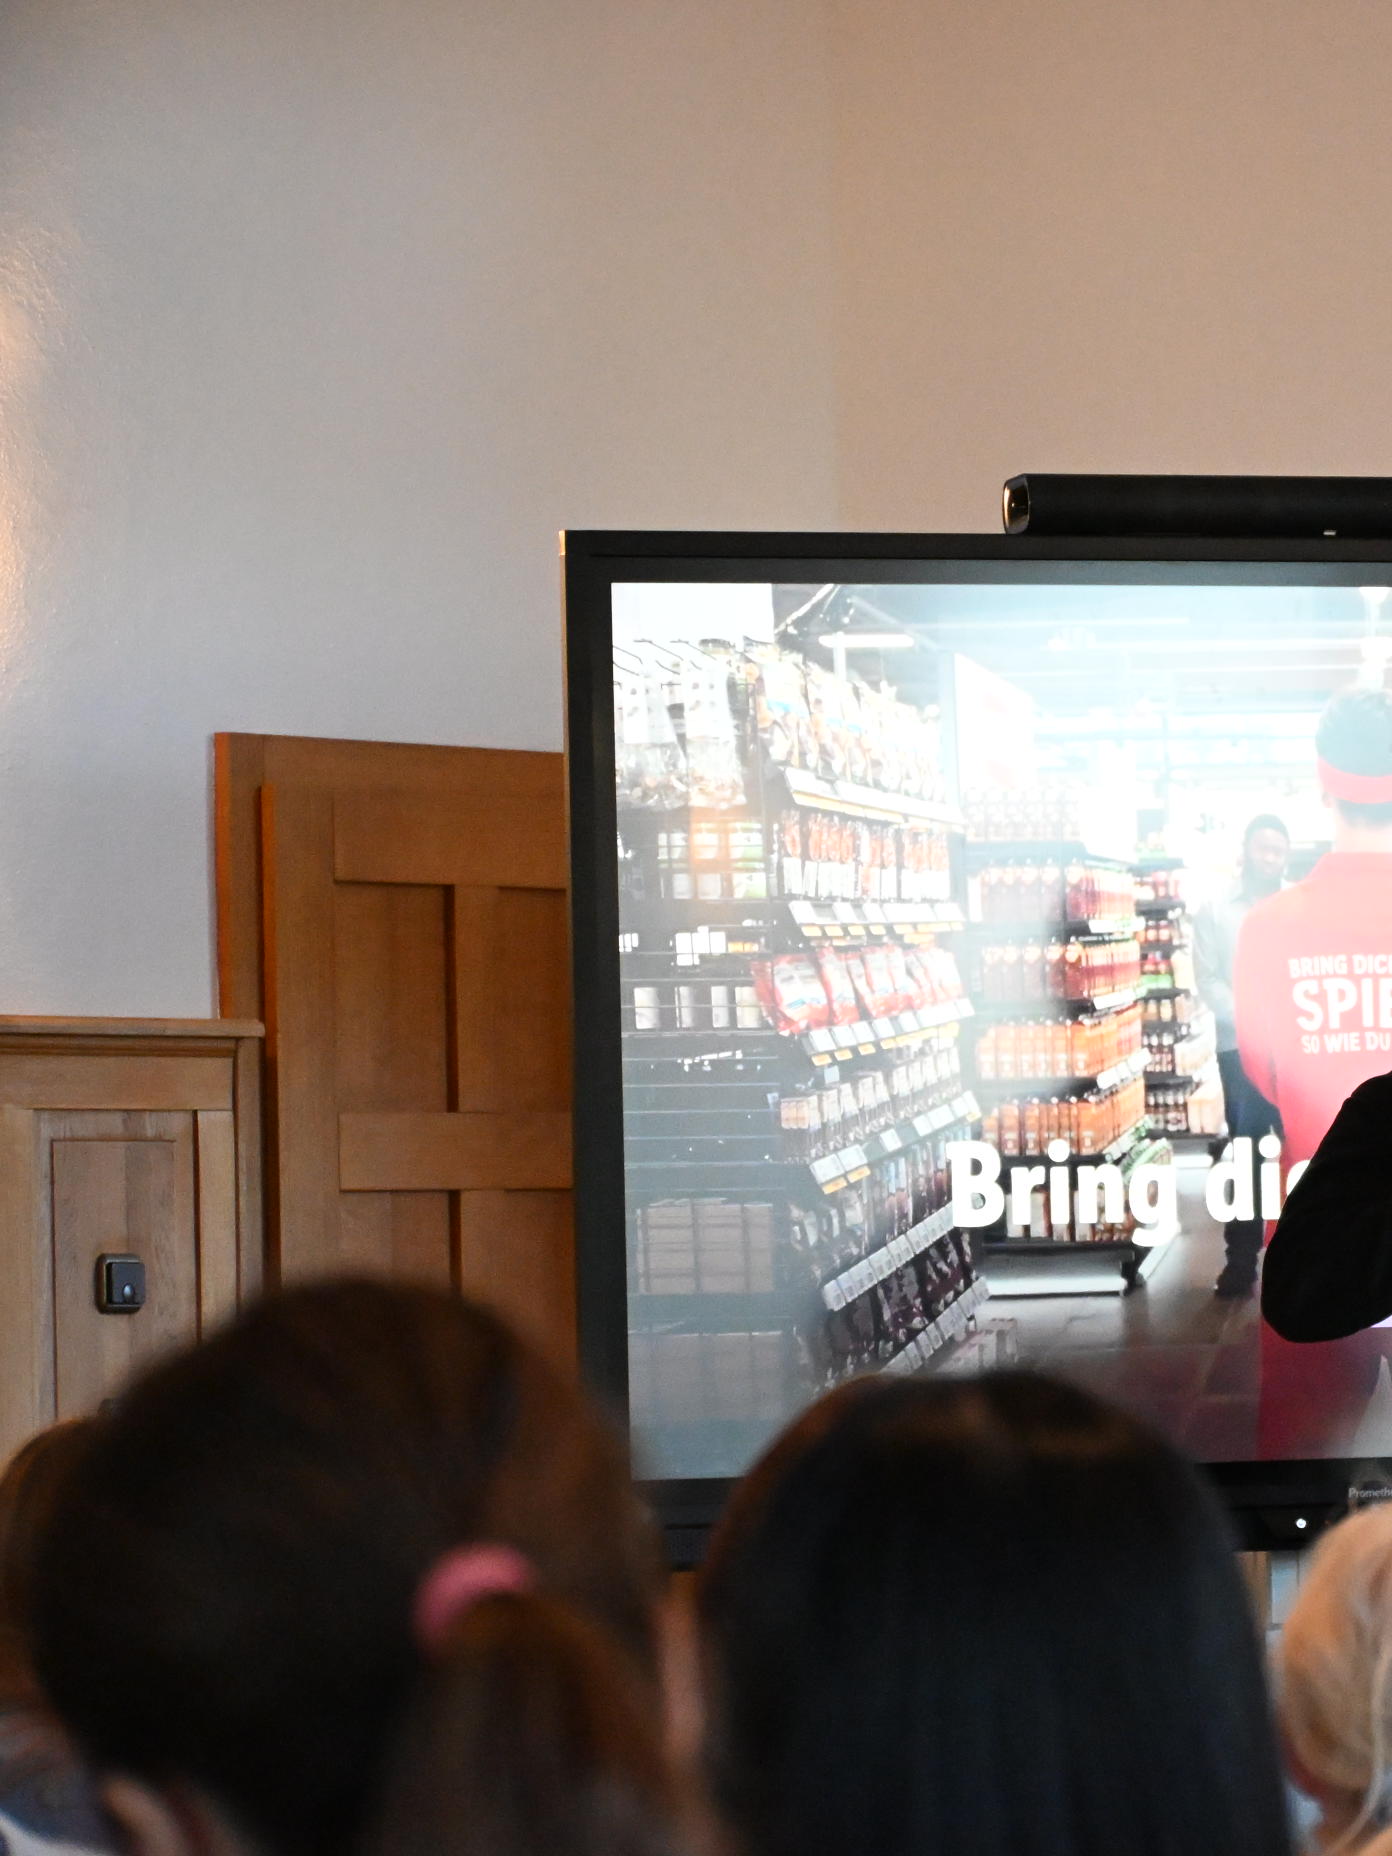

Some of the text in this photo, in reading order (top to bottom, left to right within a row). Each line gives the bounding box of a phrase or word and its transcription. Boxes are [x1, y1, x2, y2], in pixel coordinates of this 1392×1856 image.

[1288, 954, 1348, 978] BRING
[1301, 1034, 1320, 1055] SO
[1323, 1031, 1361, 1054] WIE
[1365, 1031, 1391, 1052] DU
[946, 1140, 1181, 1247] Bring
